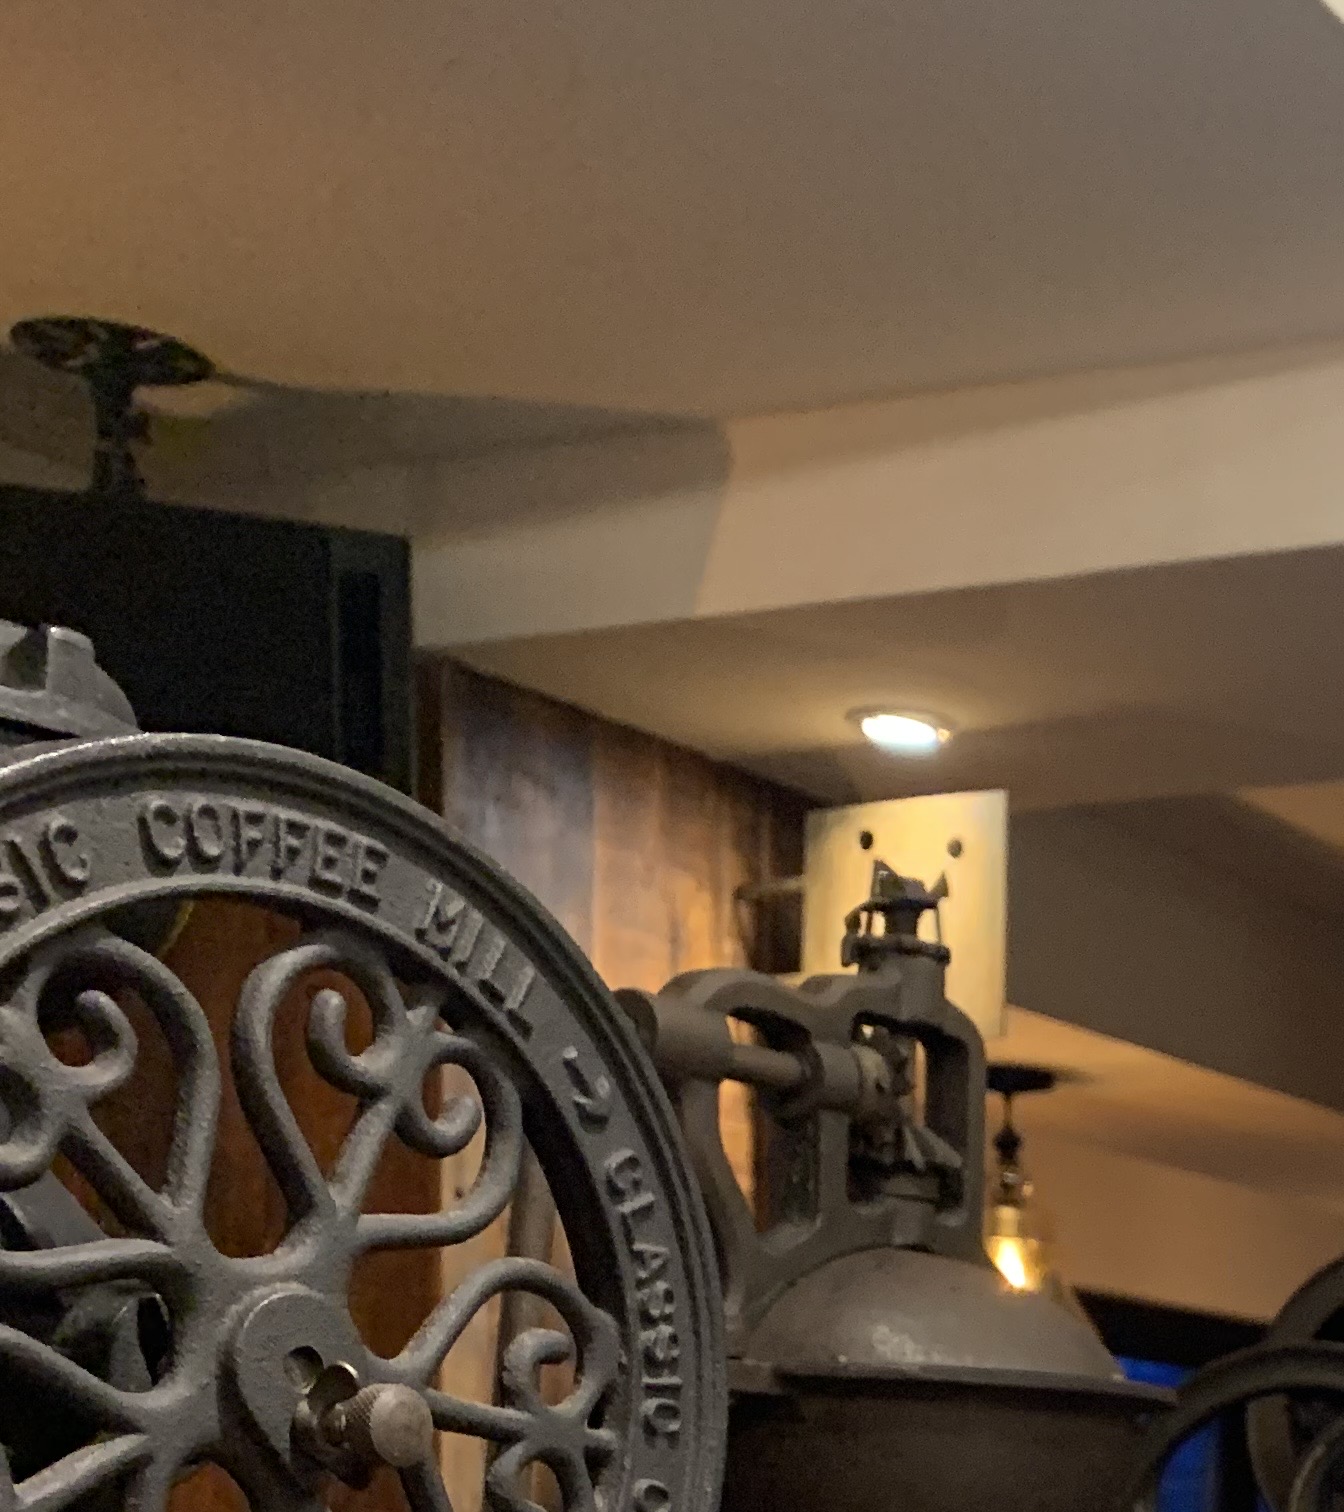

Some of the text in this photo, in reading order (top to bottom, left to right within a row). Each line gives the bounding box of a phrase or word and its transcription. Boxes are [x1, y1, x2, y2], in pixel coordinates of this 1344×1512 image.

[137, 799, 391, 907] COFFEE
[415, 878, 538, 1036] MILL
[603, 1146, 687, 1447] CLASSIC
